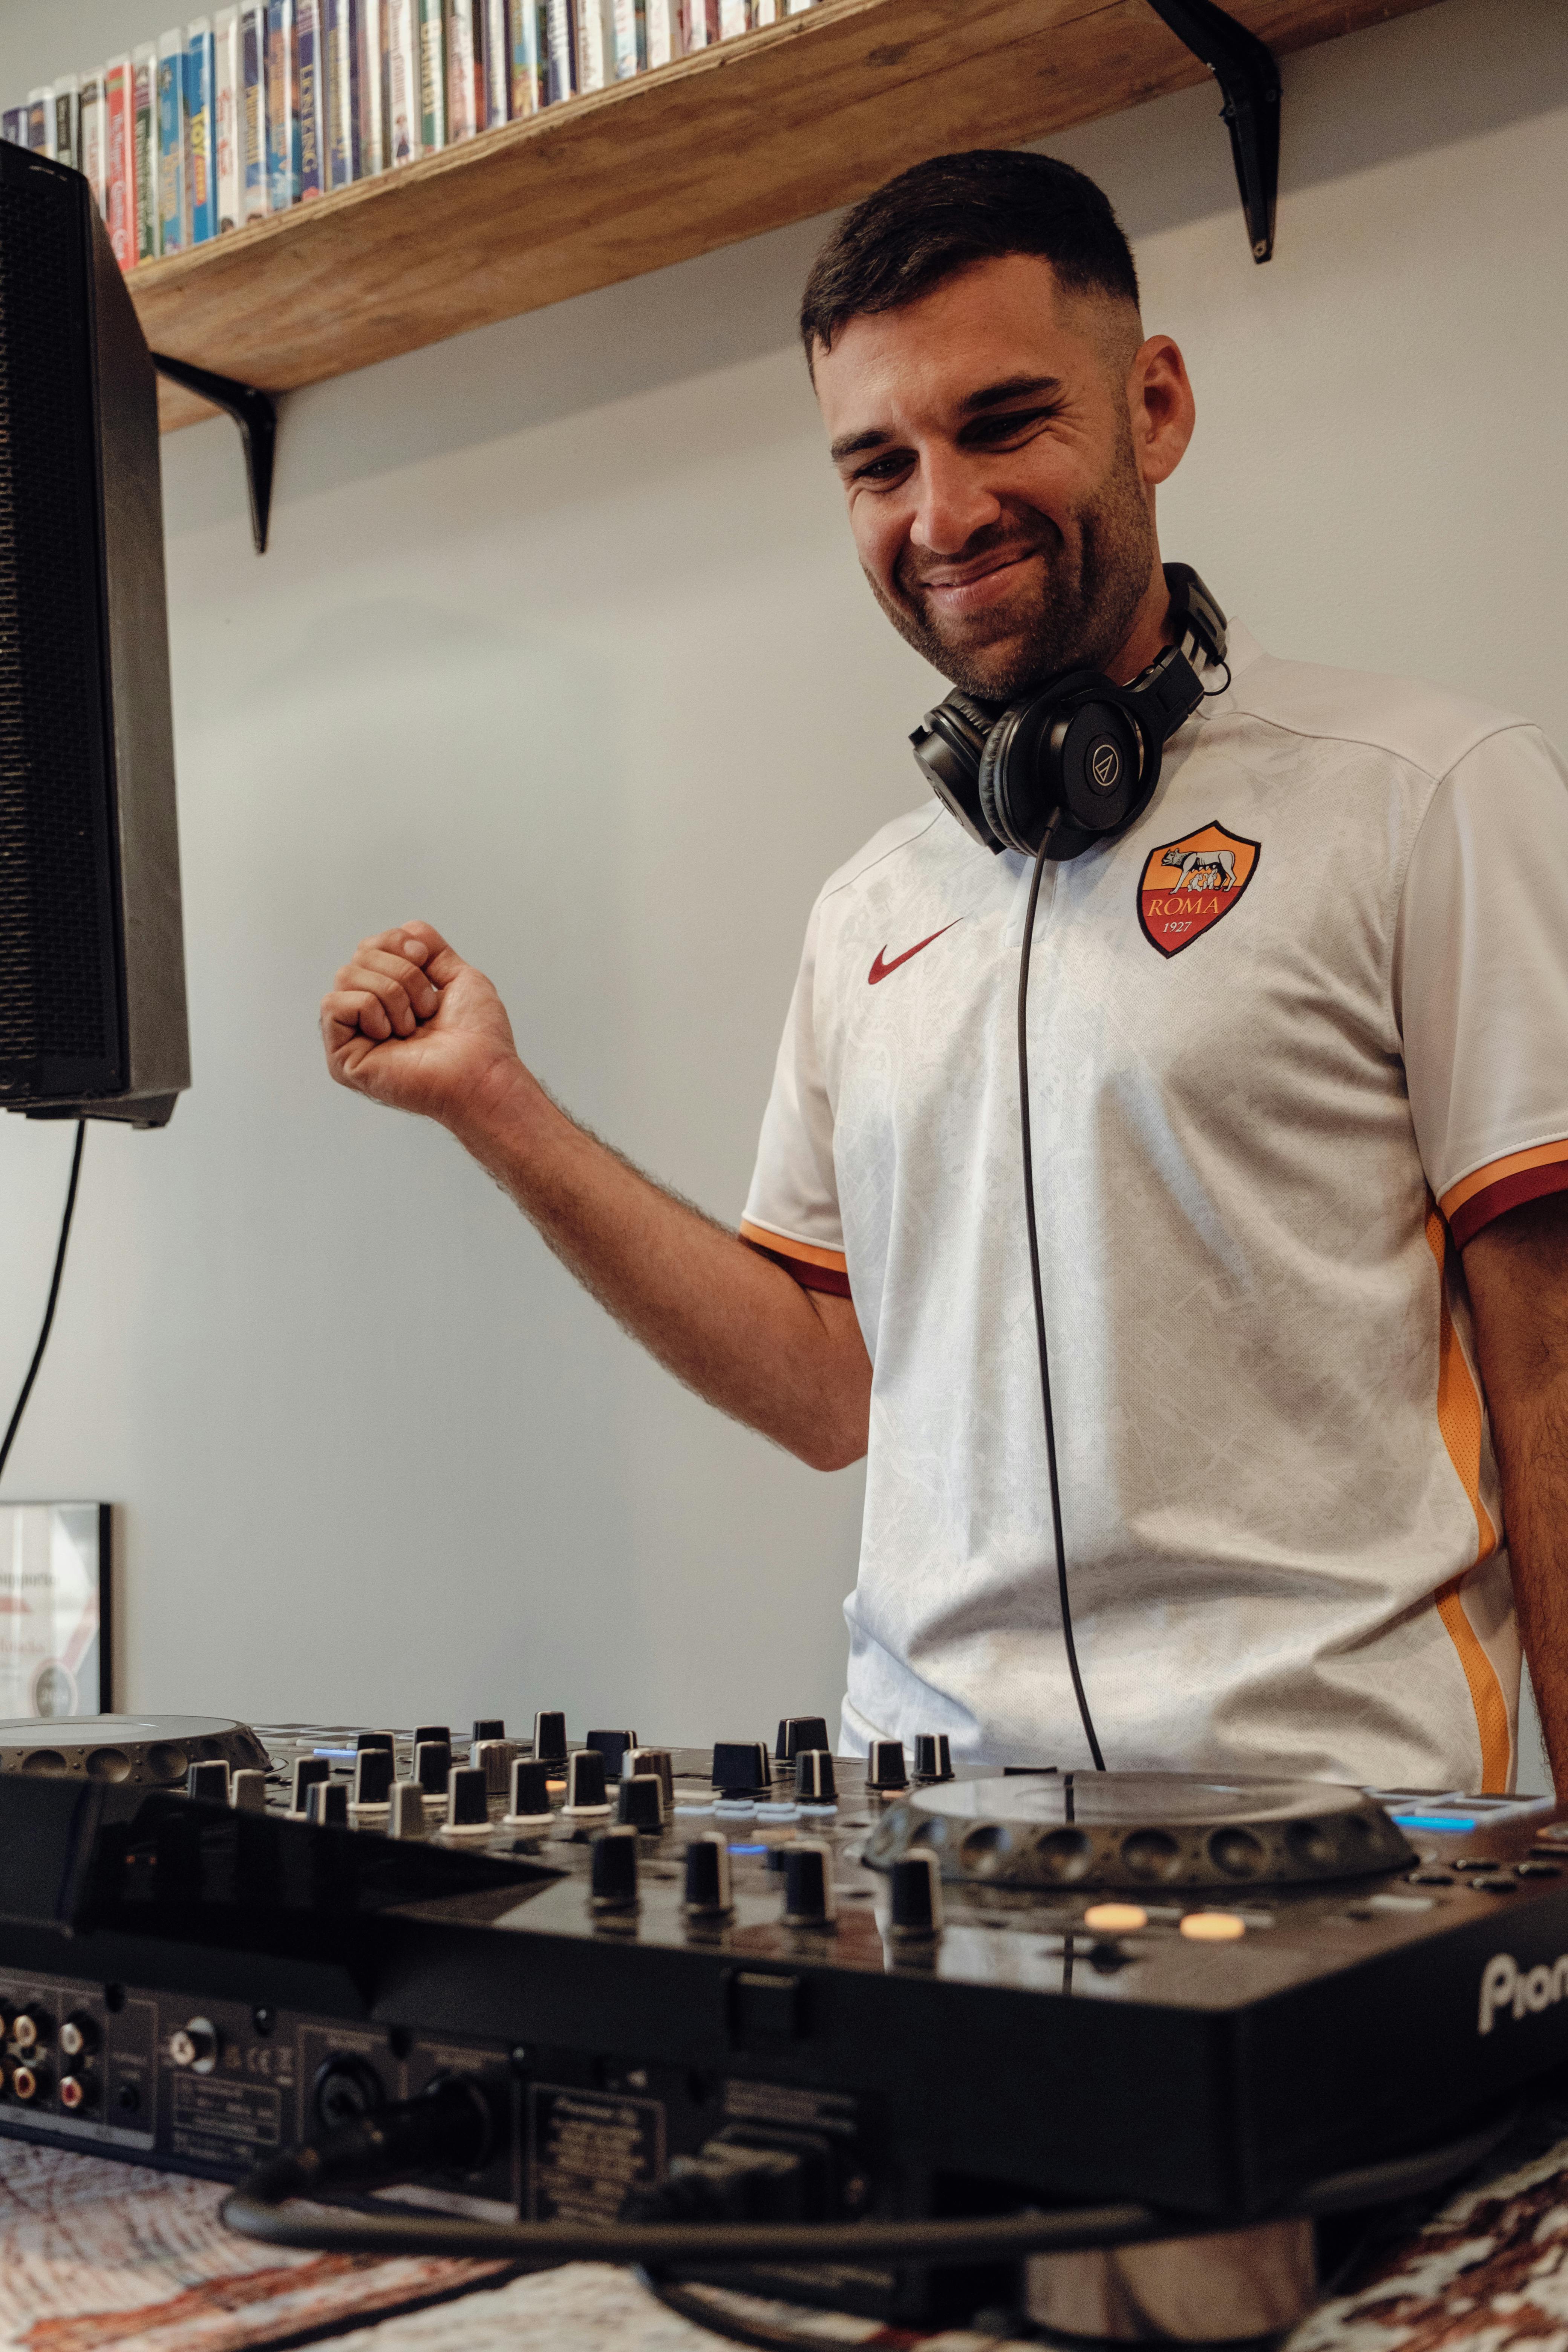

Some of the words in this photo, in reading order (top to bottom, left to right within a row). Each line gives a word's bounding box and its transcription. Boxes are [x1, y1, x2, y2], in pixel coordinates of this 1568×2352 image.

[190, 104, 210, 157] TOY
[301, 116, 317, 173] KING
[1147, 897, 1219, 916] ROMA
[1163, 922, 1192, 933] 1927
